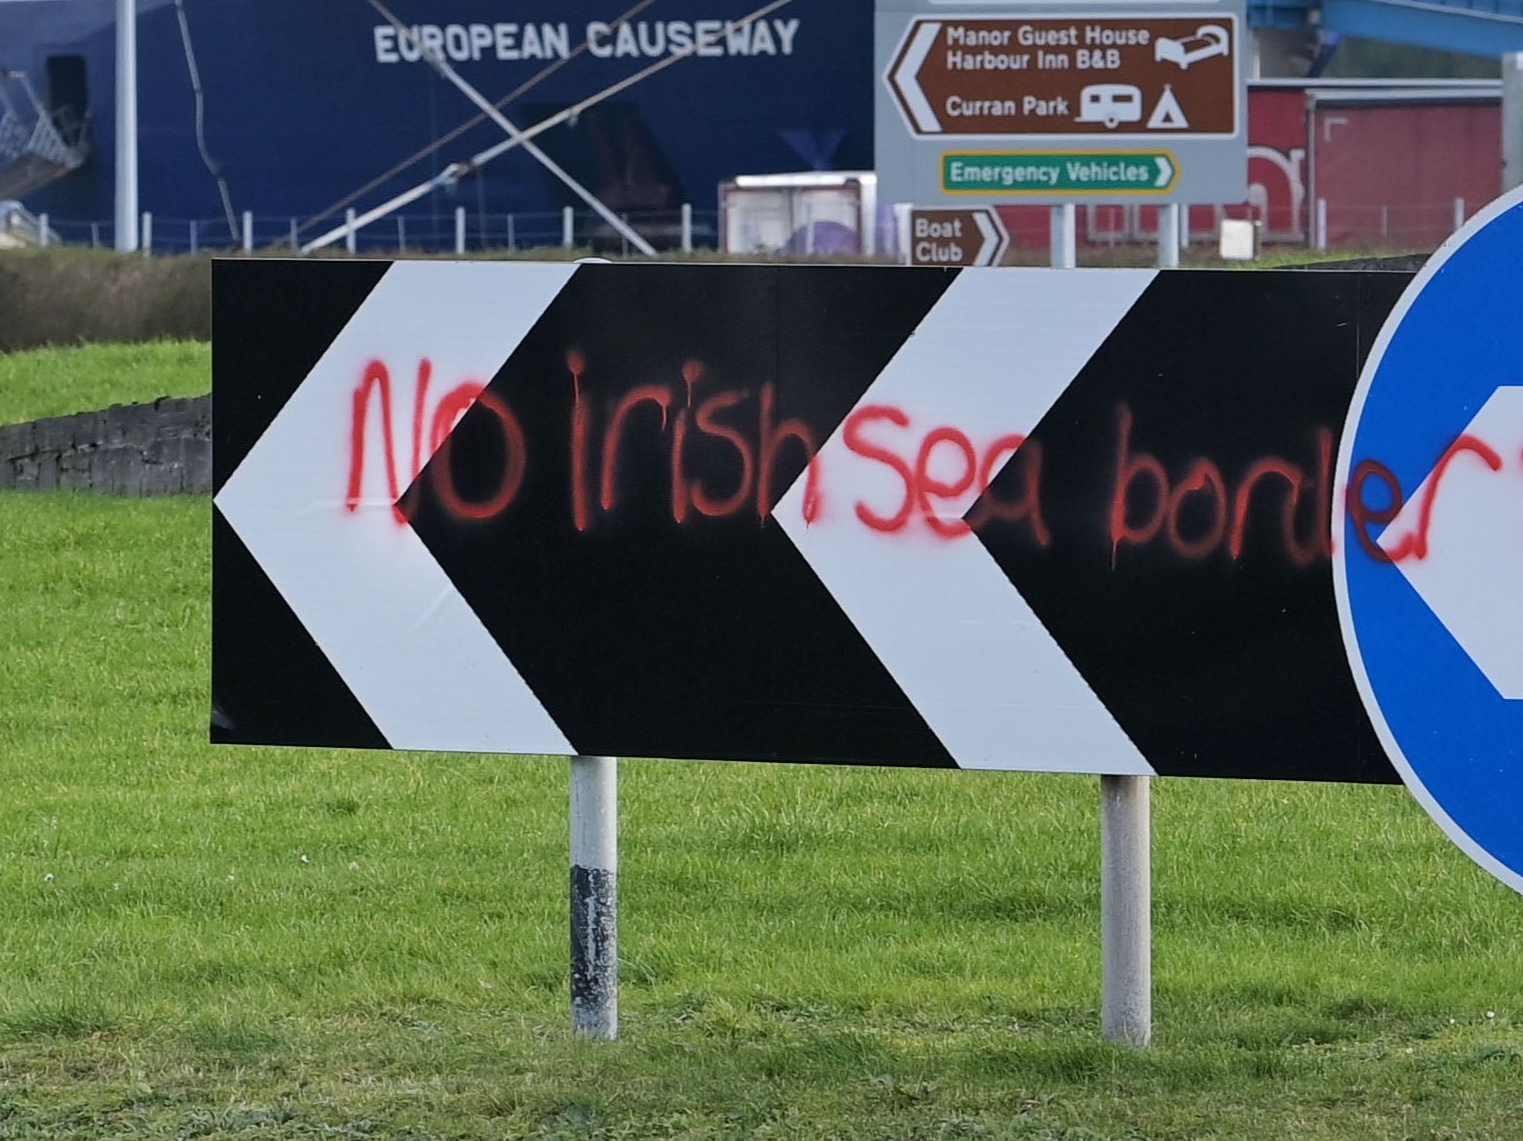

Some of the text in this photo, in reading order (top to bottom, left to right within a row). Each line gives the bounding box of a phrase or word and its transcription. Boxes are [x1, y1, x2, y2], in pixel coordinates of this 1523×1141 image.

[373, 18, 801, 64] EUROPEAN CAUSEWAY
[946, 26, 1150, 46] Manor Guest House
[946, 50, 1120, 70] Harbour Inn B&B
[945, 96, 1069, 116] Curran Park
[950, 161, 1149, 185] Emergency Vehicles
[915, 218, 963, 238] Boat
[915, 242, 963, 262] Club
[345, 357, 528, 527] No
